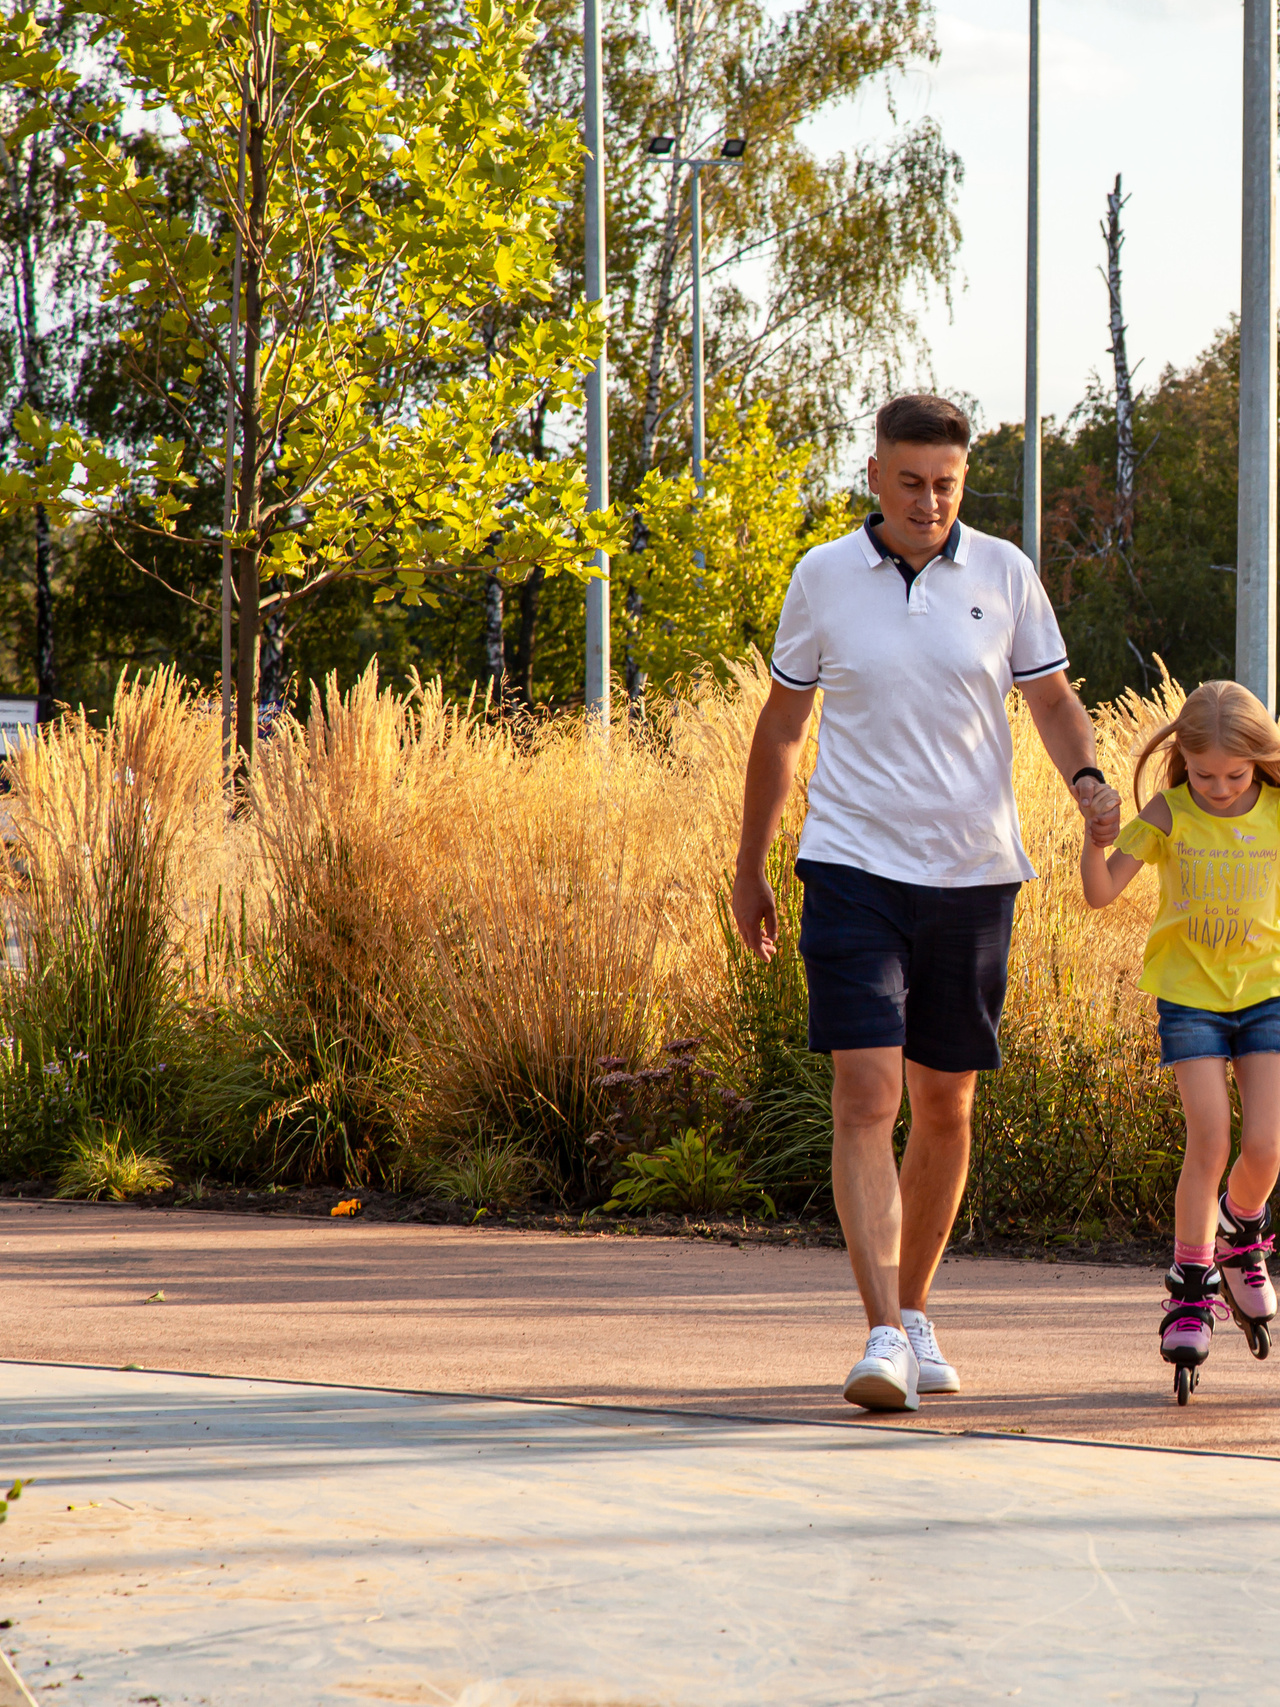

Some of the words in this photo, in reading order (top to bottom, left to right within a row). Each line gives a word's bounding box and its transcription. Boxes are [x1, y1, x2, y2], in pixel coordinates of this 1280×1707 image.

[1174, 841, 1205, 858] There
[1209, 849, 1229, 858] are
[1231, 849, 1244, 858] so
[1248, 848, 1278, 861] many
[1180, 858, 1272, 902] REASONS
[1204, 904, 1219, 915] to
[1226, 904, 1240, 915] be
[1188, 916, 1254, 949] HAPPY
